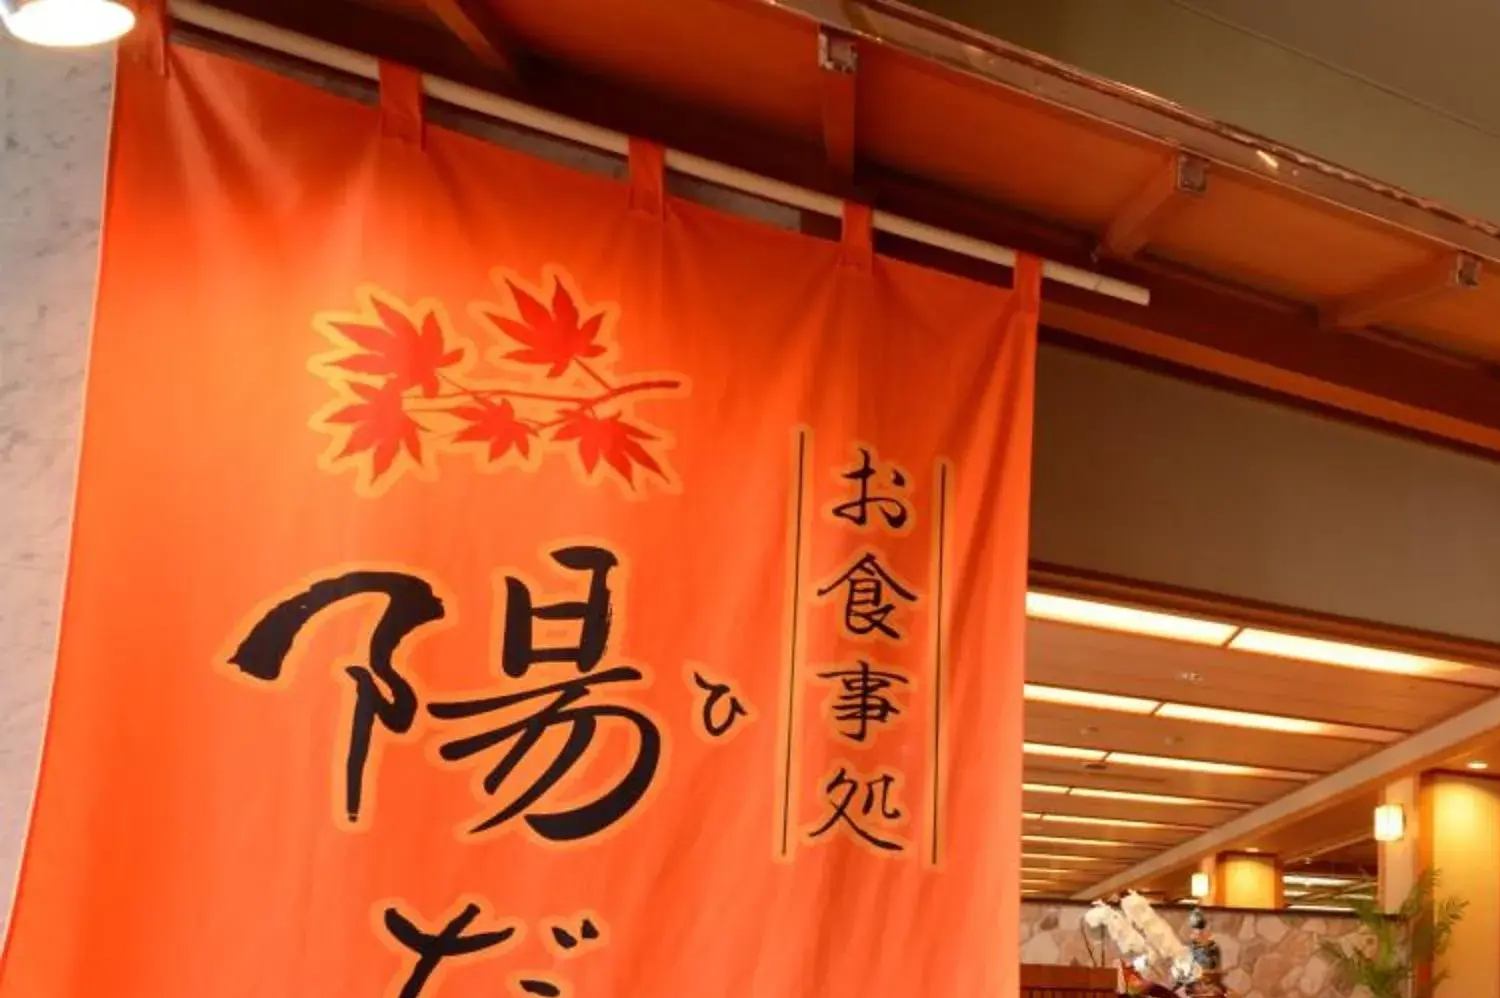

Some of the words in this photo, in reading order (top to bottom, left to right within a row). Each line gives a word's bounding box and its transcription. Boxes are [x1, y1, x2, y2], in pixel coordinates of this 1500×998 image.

[693, 671, 746, 736] ひ
[805, 449, 917, 851] お食事処
